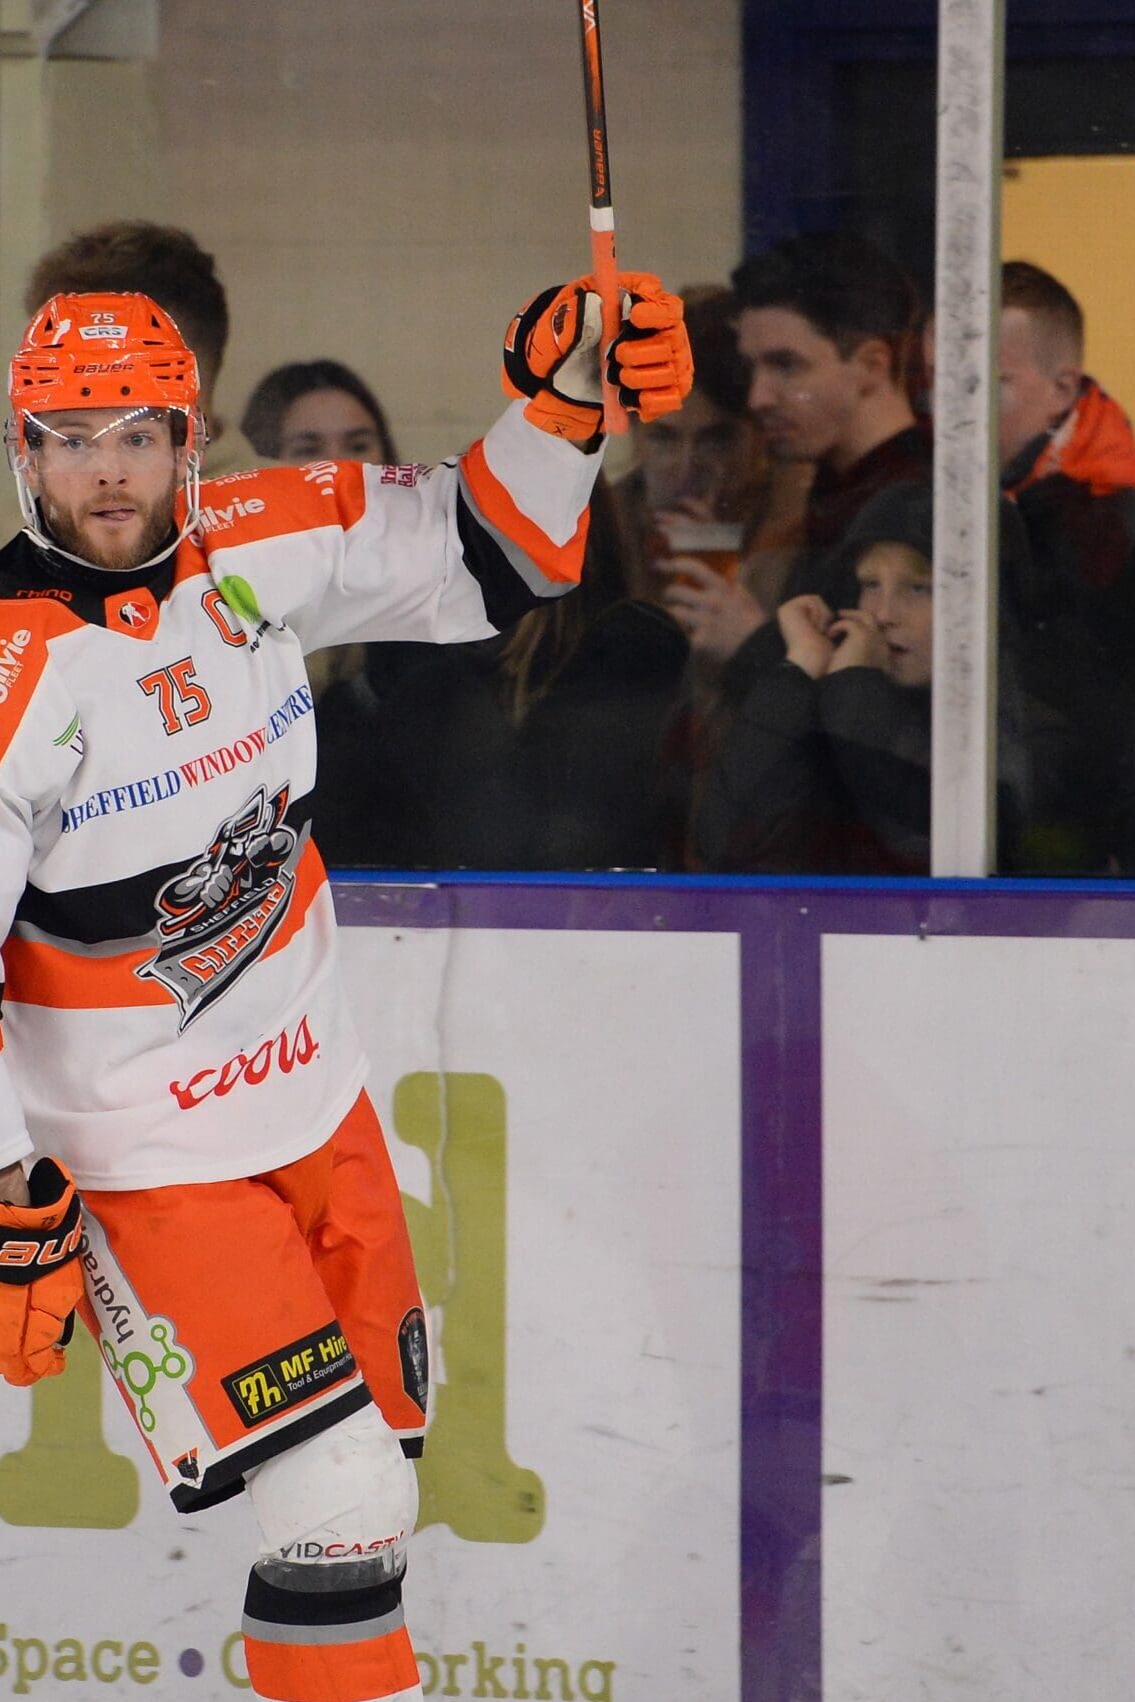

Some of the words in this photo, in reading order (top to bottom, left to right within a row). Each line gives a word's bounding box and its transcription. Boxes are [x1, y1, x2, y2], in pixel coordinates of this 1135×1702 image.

[90, 313, 115, 323] 75
[83, 327, 123, 337] CRS
[136, 655, 212, 736] 75
[179, 727, 266, 788] WINDOW
[280, 1348, 314, 1382] MF
[287, 1377, 305, 1392] Tool
